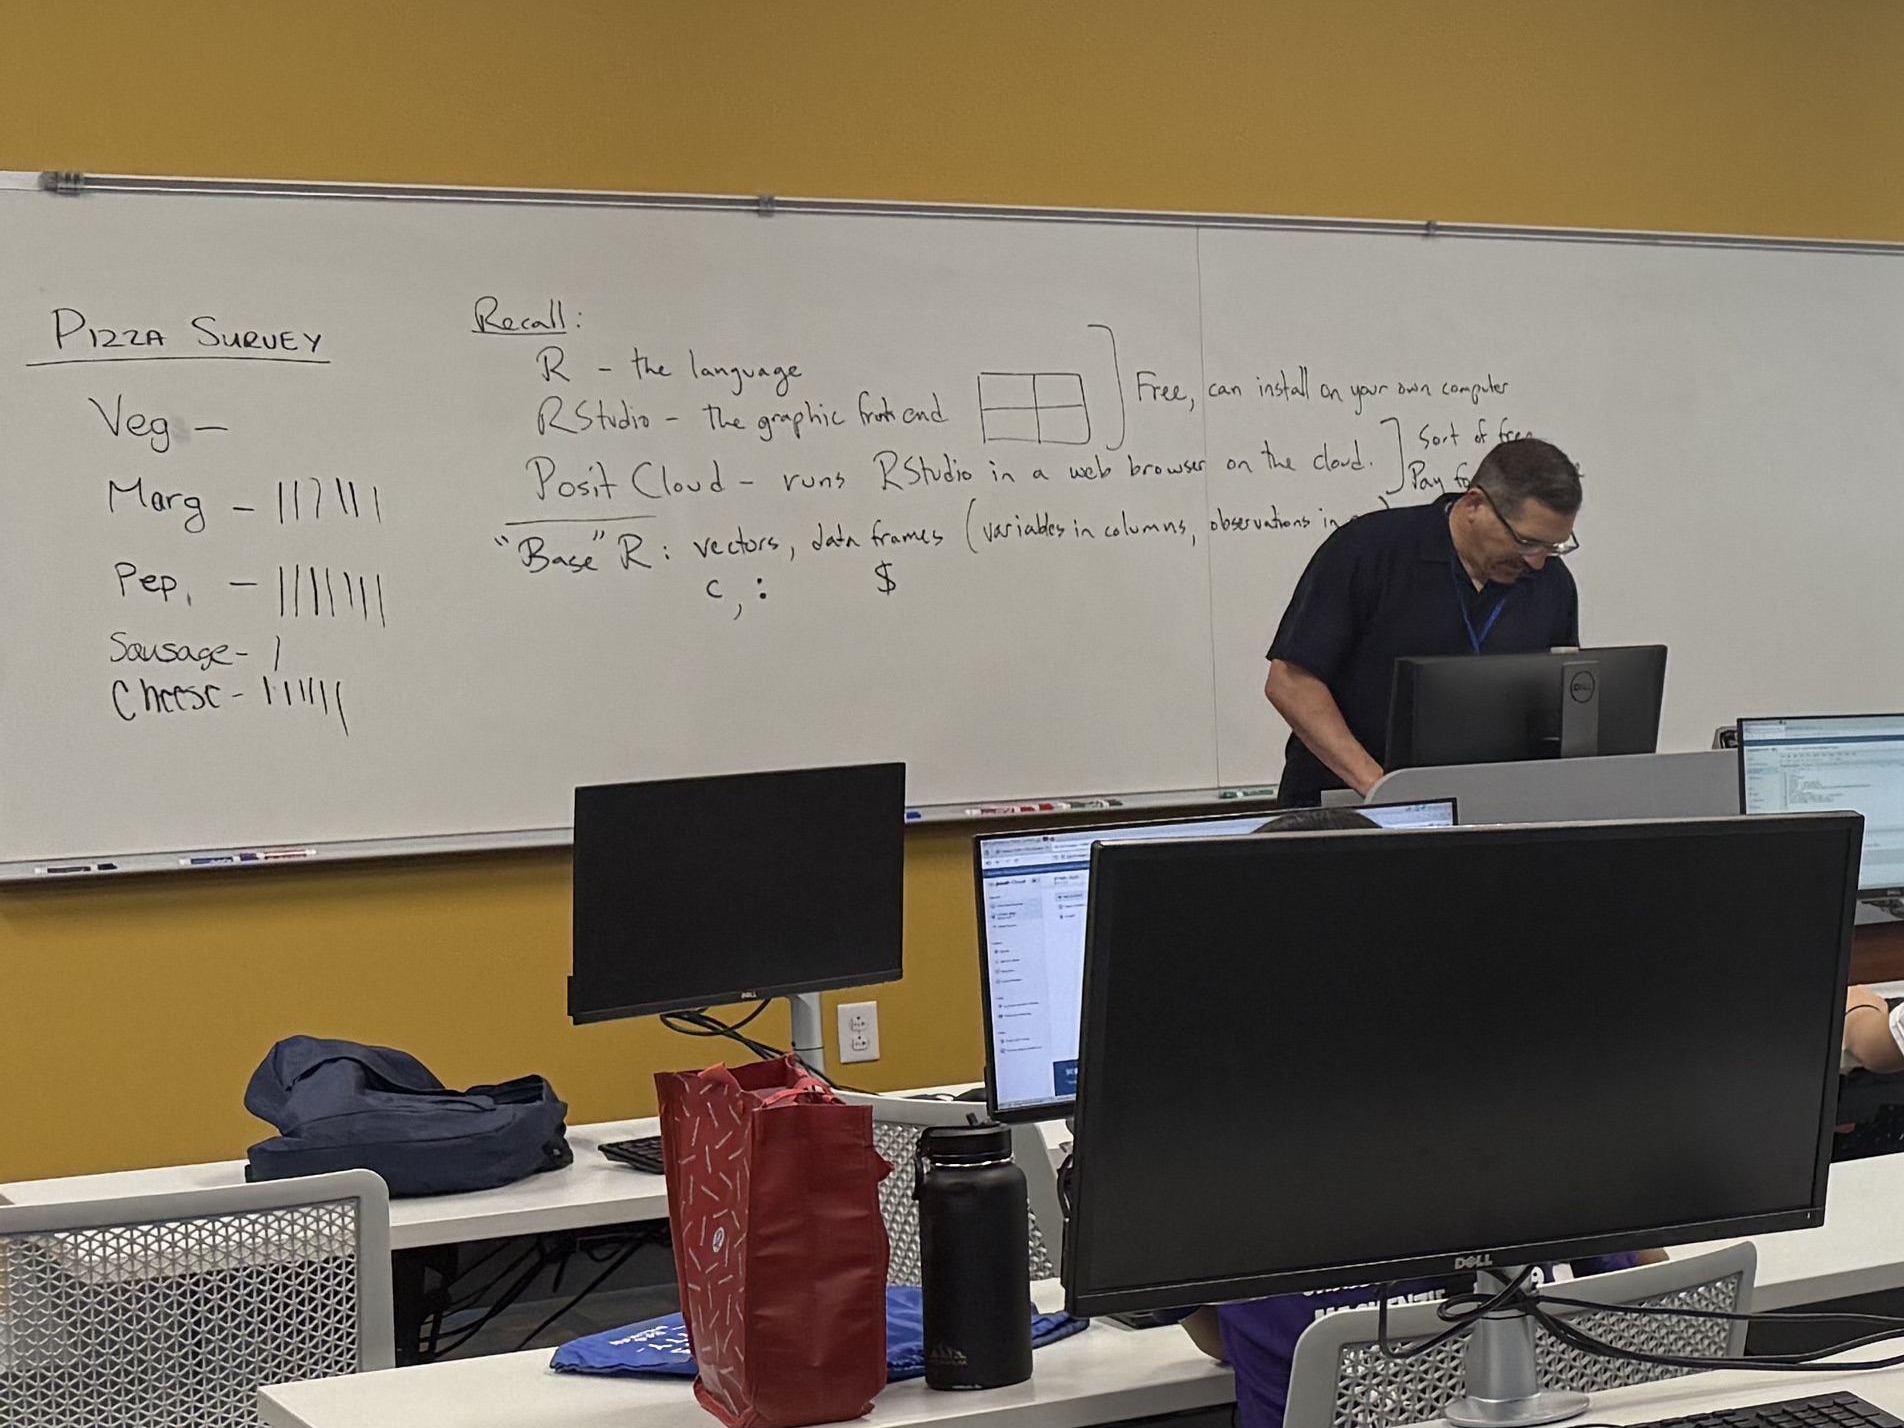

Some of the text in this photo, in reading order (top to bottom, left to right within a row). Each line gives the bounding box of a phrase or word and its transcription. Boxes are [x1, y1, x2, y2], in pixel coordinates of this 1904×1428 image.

[52, 308, 323, 352] PIZZA SURVEY
[536, 345, 570, 382] R
[631, 346, 671, 380] the
[689, 348, 802, 397] language
[1136, 365, 1509, 416] Free, can install on your own computer
[88, 393, 170, 453] Veg
[757, 400, 845, 442] graphic
[902, 392, 948, 424] end
[1419, 420, 1460, 450] Sort
[1474, 418, 1487, 444] of
[525, 455, 617, 501] Posit
[631, 459, 725, 499] Cloud
[784, 470, 845, 492] runs
[989, 460, 1015, 483] in
[1032, 466, 1048, 480] a
[1069, 454, 1112, 479] web
[1128, 454, 1207, 477] browser
[1226, 458, 1253, 474] on
[1260, 440, 1297, 471] the
[1408, 460, 1445, 493] Pay
[108, 476, 206, 533] Marg
[812, 522, 860, 551] data
[871, 519, 944, 547] frames
[1074, 519, 1095, 539] in
[1210, 506, 1310, 532] observations
[874, 559, 897, 596] $
[1454, 1254, 1493, 1270] DELL
